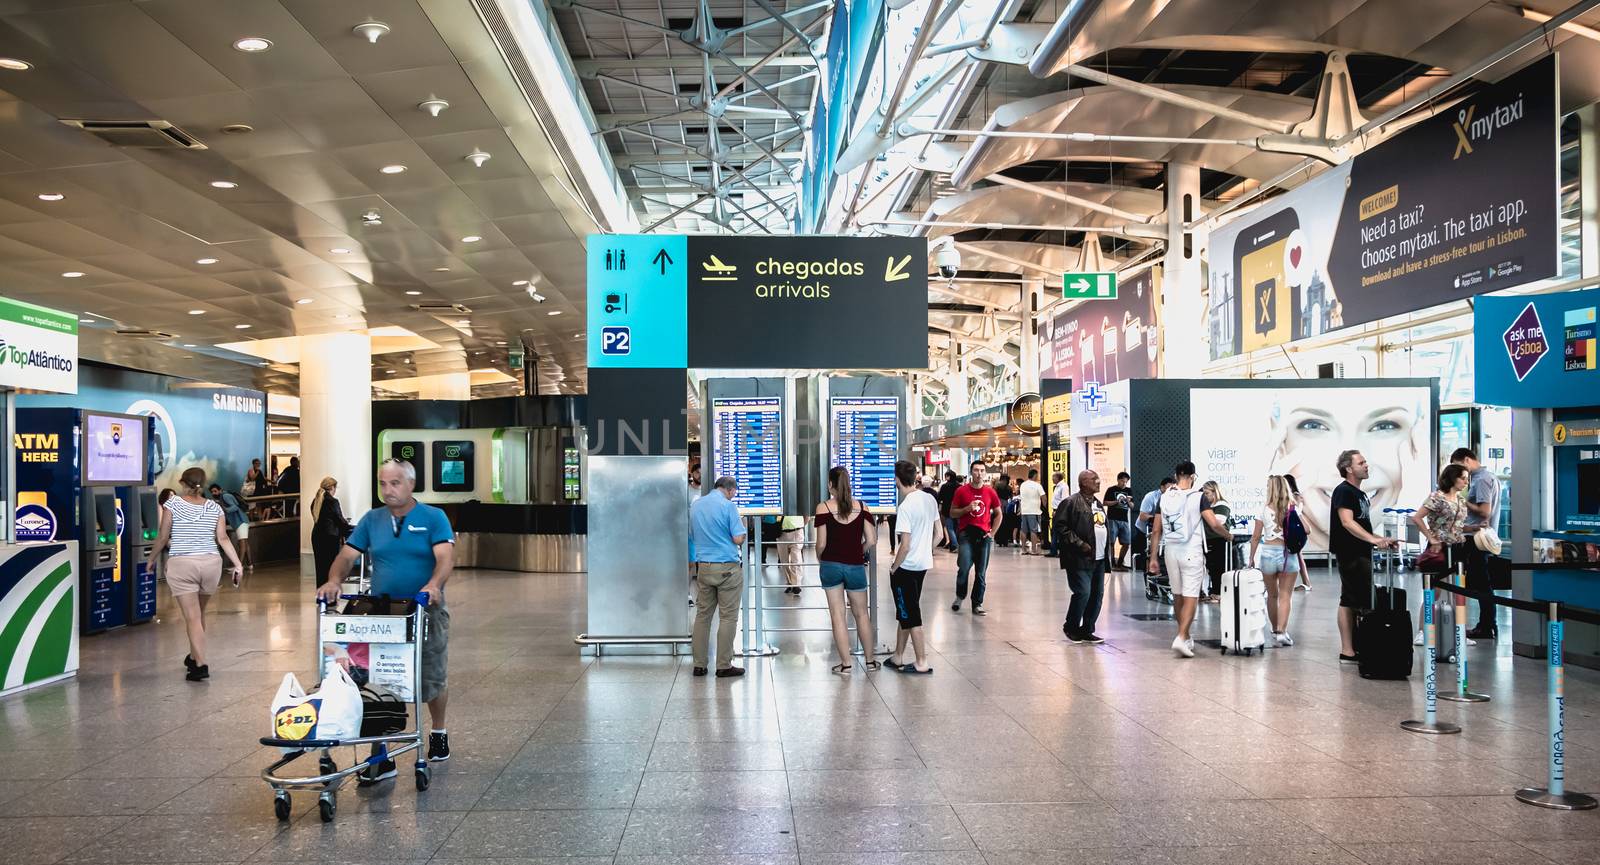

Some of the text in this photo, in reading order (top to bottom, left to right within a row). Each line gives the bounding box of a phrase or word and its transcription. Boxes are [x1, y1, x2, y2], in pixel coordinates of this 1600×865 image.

[1471, 92, 1524, 140] mytaxi
[1362, 191, 1396, 216] WELCOME!
[1361, 205, 1424, 246] Need a taxi?
[1361, 199, 1528, 268] Choose mytaxi. The taxi app.
[1362, 268, 1392, 287] Download
[1393, 266, 1405, 280] and
[1406, 260, 1422, 276] have
[1429, 247, 1467, 267] stress-free
[1469, 241, 1485, 255] tour
[1487, 236, 1495, 248] in
[1497, 228, 1527, 246] Lisbon.
[755, 257, 864, 280] chegadas
[755, 282, 830, 299] arrivals
[602, 332, 629, 351] P2
[1510, 327, 1542, 341] ask me
[1566, 328, 1592, 340] Turismo
[8, 345, 73, 373] TopAtlântico
[1565, 345, 1573, 356] de
[1565, 360, 1587, 371] Lisboa
[213, 393, 263, 414] SAMSUNG
[15, 433, 59, 450] ATM
[23, 453, 59, 463] HERE
[1207, 448, 1237, 461] viajar
[1207, 463, 1235, 472] com
[349, 623, 393, 638] App ANA
[1551, 641, 1560, 655] SALE
[1551, 655, 1559, 665] ON
